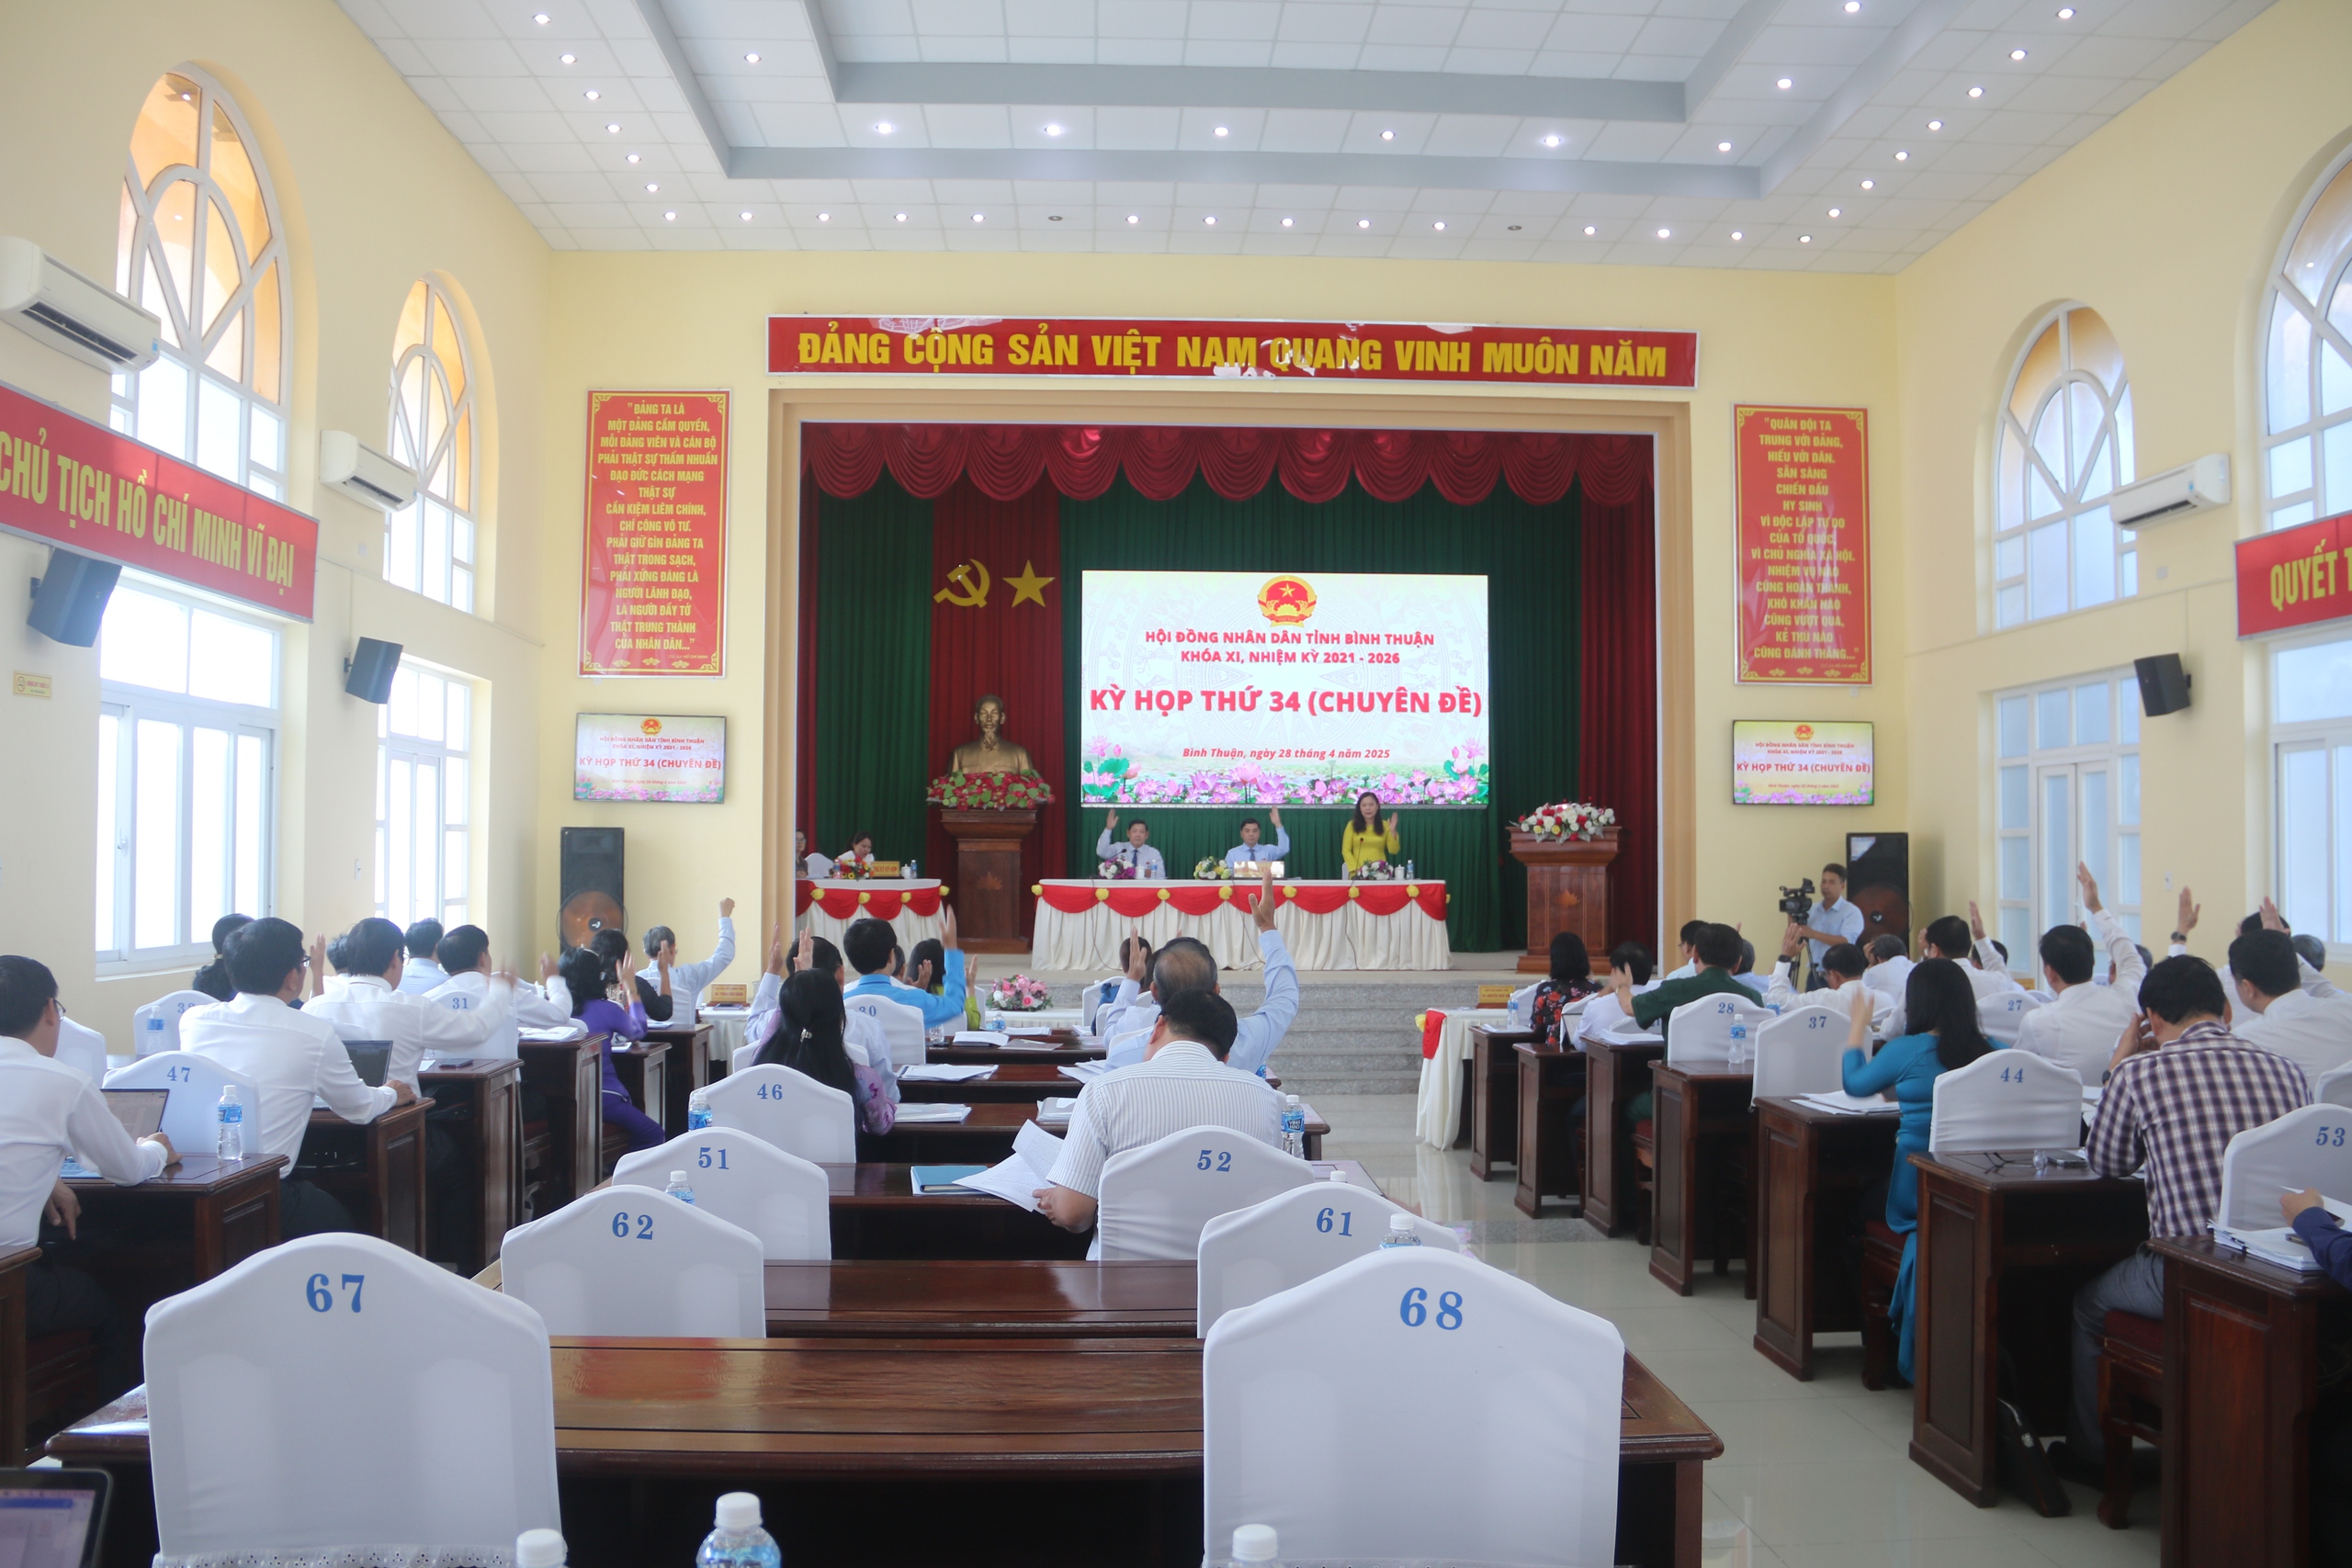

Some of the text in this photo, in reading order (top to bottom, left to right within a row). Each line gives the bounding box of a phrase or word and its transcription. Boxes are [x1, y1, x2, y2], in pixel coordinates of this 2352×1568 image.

[797, 321, 1667, 377] ĐẢNG CỘNG SẢN VIỆT NAM QUANG VINH MUÔN NĂM
[661, 404, 672, 414] TA
[673, 402, 684, 414] LÀ
[608, 416, 710, 433] MỘT ĐẢNG CẦM QUYỀN,
[1800, 418, 1816, 433] ĐỘI
[1819, 420, 1832, 431] TA
[601, 433, 717, 451] MỖI ĐẢNG VIÊN VÀ CÁN BỘ
[1758, 432, 1843, 448] TRUNG VỚI ĐẢNG,
[598, 449, 718, 467] PHẢI THẬT SỰ THẤM NHUẦN
[1768, 448, 1791, 461] HIẾU
[1793, 449, 1809, 462] VỚI
[610, 468, 704, 484] ĐẠO ĐỨC CÁCH MẠNG
[1800, 466, 1827, 479] SÀNG
[639, 485, 675, 500] THẬT SỰ
[1776, 480, 1828, 495] CHIẾN ĐẤU
[0, 427, 294, 596] CHỦ TỊCH HỒ CHÍ MINH VĨ ĐẠI
[1782, 501, 1823, 512] HY SINH
[614, 552, 695, 568] THẬT TRONG SẠCH,
[2270, 538, 2338, 612] QUYẾT
[610, 619, 695, 634] THẬT TRUNG THÀNH
[615, 634, 633, 649] CỦA
[636, 637, 661, 649] NHÂN
[1145, 627, 1435, 647] HỘI ĐỒNG NHÂN DÂN TỈNH BÌNH THUẬN
[1181, 649, 1221, 663] KHÓA
[1225, 650, 1246, 665] XI,
[1249, 650, 1296, 667] NHIỆM
[1301, 649, 1319, 663] KỲ
[1323, 651, 1355, 664] 2021
[1367, 651, 1400, 664] 2026
[1090, 682, 1482, 717] KỲ HỌP THỨ 34 (CHUYÊN ĐỀ)
[579, 755, 721, 770] KỲ HỌP THỨ 34 (CHUYÊN ĐỀ)
[1182, 747, 1391, 762] Bình Thuận, ngày 28 tháng 4 năm 2025
[1736, 761, 1748, 772] KỲ
[1752, 763, 1771, 773] HỌP
[1774, 761, 1794, 772] THỨ
[1811, 762, 1853, 773] (CHUYÊN
[1856, 761, 1871, 773] ĐỀ)
[452, 998, 469, 1010] 31
[1718, 1002, 1735, 1015] 28
[2007, 999, 2022, 1011] 27
[1809, 1016, 1826, 1029] 37
[166, 1066, 191, 1083] 47
[2000, 1066, 2025, 1084] 44
[756, 1083, 783, 1100] 46
[2315, 1126, 2346, 1147] 53
[697, 1147, 729, 1170] 51
[1196, 1149, 1232, 1173] 52
[612, 1213, 654, 1240] 62
[1316, 1207, 1353, 1237] 61
[305, 1273, 366, 1314] 67
[1399, 1287, 1464, 1331] 68
